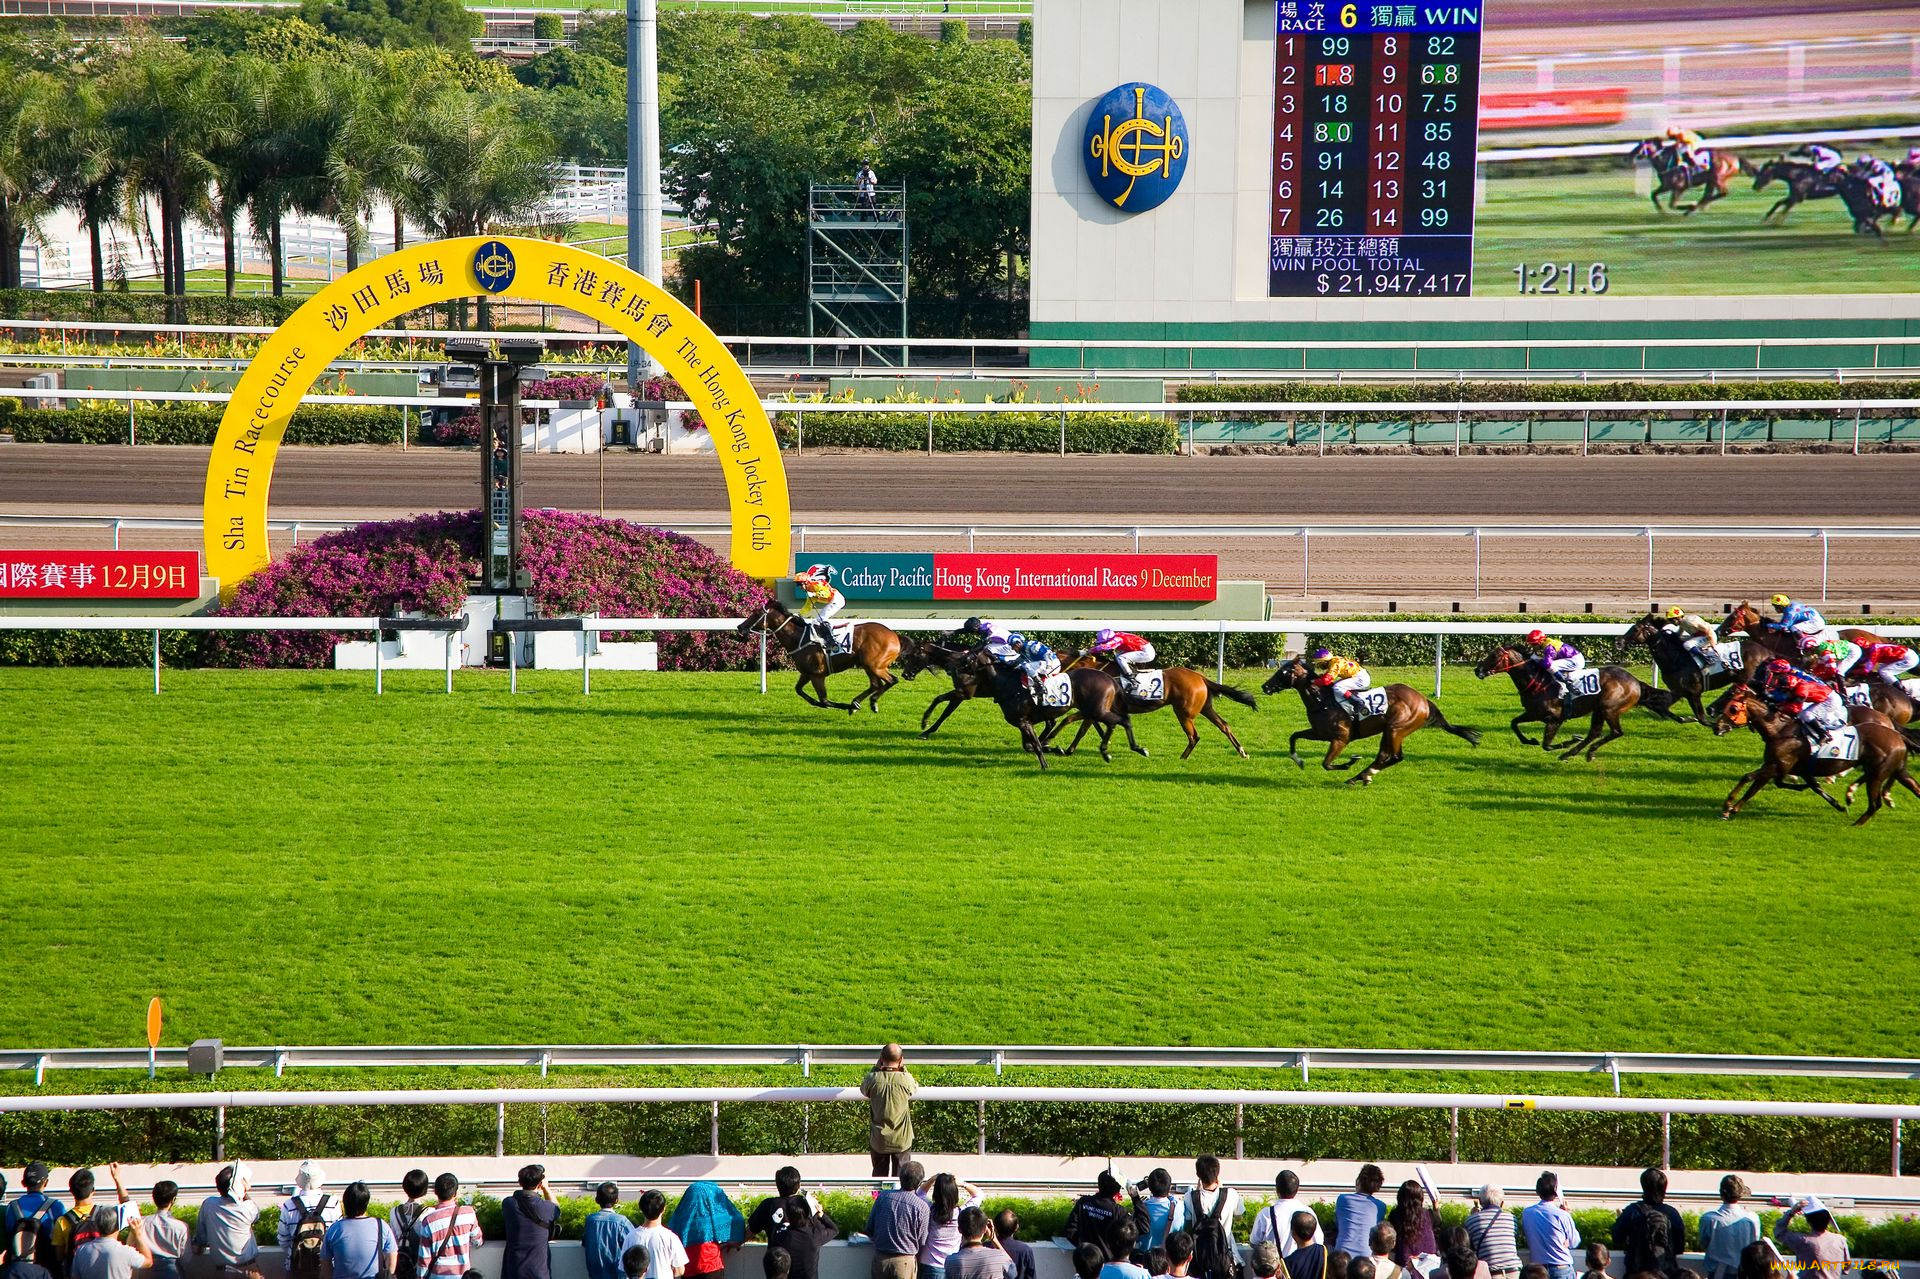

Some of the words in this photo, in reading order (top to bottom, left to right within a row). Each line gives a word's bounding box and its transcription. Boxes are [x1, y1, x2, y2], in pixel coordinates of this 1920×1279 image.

[1280, 1, 1325, 18] 場次
[1340, 4, 1358, 28] 6
[1370, 5, 1417, 27] 獨贏
[1425, 7, 1478, 26] WIN
[1281, 19, 1325, 31] RACE
[1284, 38, 1294, 56] 1
[1322, 38, 1349, 55] 99
[1384, 37, 1396, 55] 8
[1428, 37, 1455, 55] 82
[1282, 67, 1295, 84] 2
[1318, 66, 1353, 84] 1.8
[1383, 66, 1396, 84] 9
[1422, 65, 1457, 84] 6.8
[1282, 95, 1295, 113] 3
[1321, 95, 1347, 112] 18
[1376, 95, 1402, 112] 10
[1422, 94, 1456, 112] 7.5
[1280, 125, 1293, 141] 4
[1316, 124, 1351, 142] 8.0
[1375, 124, 1398, 141] 11
[1424, 123, 1451, 141] 85
[1281, 153, 1293, 170] 5
[1318, 152, 1342, 170] 91
[1374, 152, 1399, 170] 12
[1422, 152, 1450, 170] 48
[1279, 181, 1292, 198] 6
[1318, 181, 1343, 198] 14
[1373, 180, 1399, 198] 13
[1422, 180, 1446, 198] 31
[1279, 209, 1292, 226] 7
[1316, 209, 1343, 226] 26
[1372, 209, 1397, 226] 14
[1421, 209, 1448, 226] 99
[1272, 237, 1400, 257] 獨贏投注總額
[1272, 258, 1305, 271] WIN
[1312, 258, 1361, 271] POOL
[1370, 258, 1425, 271] TOTAL
[1317, 273, 1330, 294] $
[1338, 274, 1467, 296] 21,947,417
[1513, 262, 1609, 294] 1:21.6
[323, 259, 443, 332] 沙田馬場
[547, 260, 673, 339] 香港賽馬會
[675, 336, 702, 369] The
[698, 365, 731, 410] Hong
[234, 346, 306, 456] Racecourse
[725, 408, 750, 454] Kong
[224, 467, 249, 499] Tin
[736, 456, 766, 507] Jockey
[223, 515, 245, 550] Sha
[751, 514, 772, 551] Club
[0, 562, 97, 589] 際賽事
[841, 566, 887, 593] Cathay
[890, 566, 932, 587] Pacific
[935, 567, 972, 594] Hong
[976, 567, 1011, 594] Kong
[1015, 566, 1098, 587] International
[1102, 567, 1138, 587] Races
[1140, 568, 1148, 589] 9
[1152, 568, 1212, 588] December
[840, 632, 851, 653] 4
[1060, 683, 1070, 705] 3
[1150, 678, 1162, 698] 2
[1579, 674, 1598, 694] 10
[1366, 693, 1385, 714] 12
[1844, 733, 1856, 759] 7
